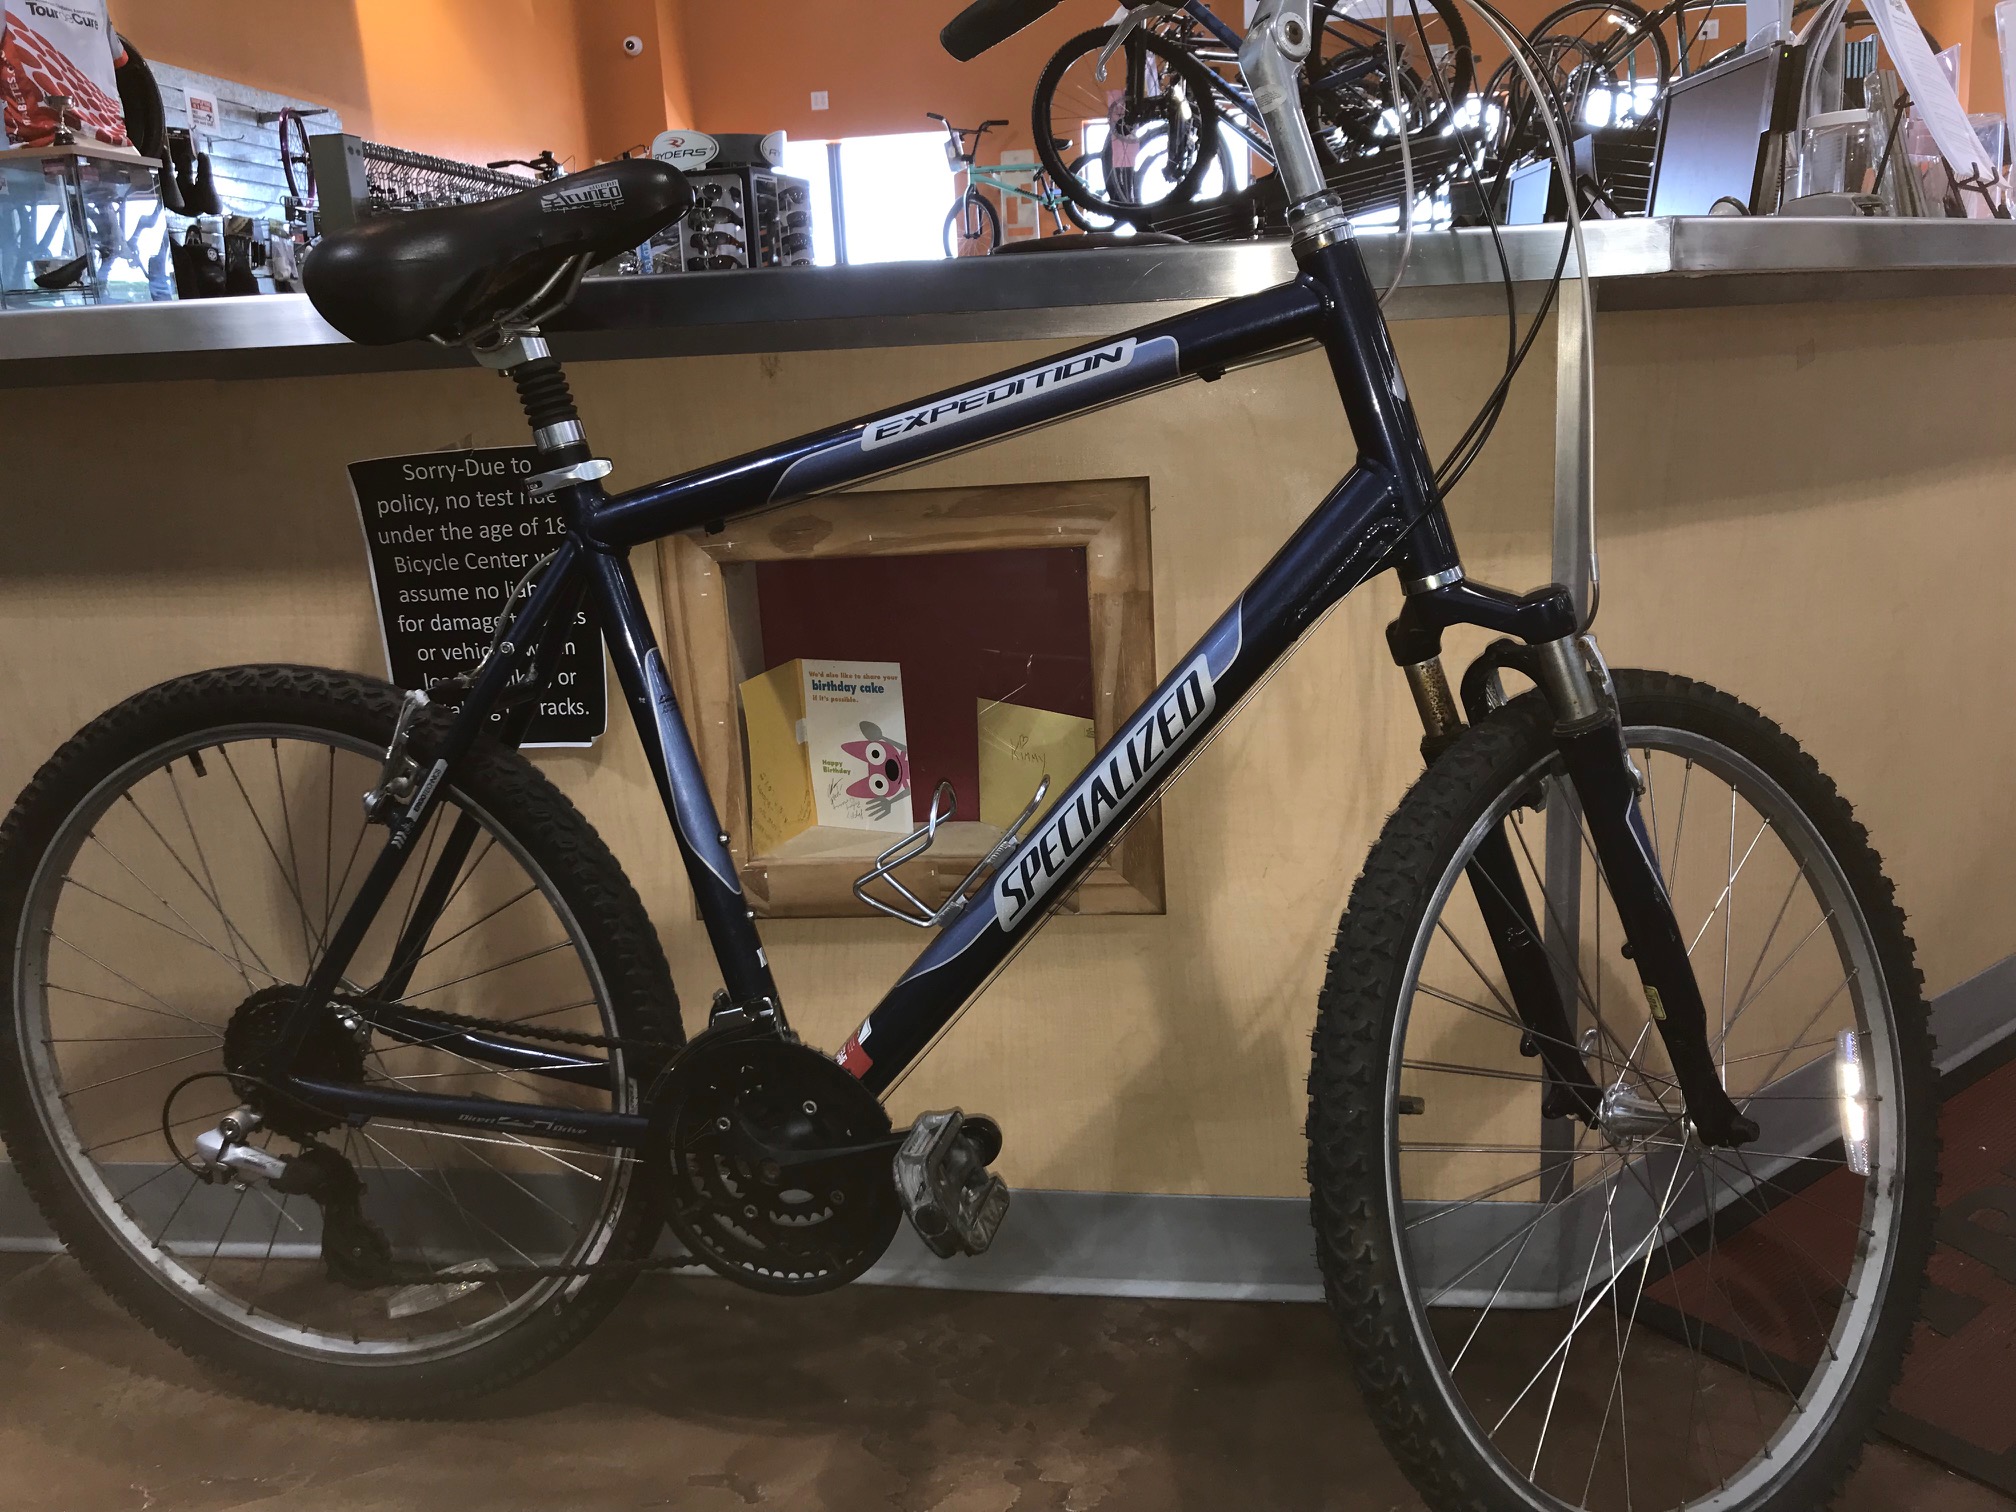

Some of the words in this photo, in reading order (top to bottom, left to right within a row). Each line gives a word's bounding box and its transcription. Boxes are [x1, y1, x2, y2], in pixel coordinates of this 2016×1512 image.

[25, 2, 59, 19] Tour
[72, 13, 99, 30] Cure
[655, 147, 708, 160] RYDERS
[874, 346, 1124, 441] EXPEDITION
[402, 458, 506, 483] Sorry-Due
[510, 457, 532, 474] to
[377, 492, 439, 519] policy,
[445, 494, 471, 510] no
[475, 489, 515, 508] test
[520, 489, 558, 505] re
[378, 524, 435, 545] under
[439, 521, 474, 541] the
[479, 523, 513, 542] age
[519, 516, 539, 536] of
[544, 516, 568, 535] 18
[394, 552, 460, 576] Bicycle
[464, 552, 529, 571] Center
[399, 585, 470, 604] assume
[475, 585, 500, 600] no
[397, 614, 425, 633] for
[430, 613, 502, 634] damage
[417, 647, 437, 661] or
[557, 671, 578, 686] or
[811, 679, 857, 695] birthday
[859, 682, 885, 694] cake
[540, 696, 590, 716] racks.
[821, 759, 843, 768] Happy
[822, 766, 852, 776] Birthday
[1001, 669, 1206, 922] SPECIALIZED
